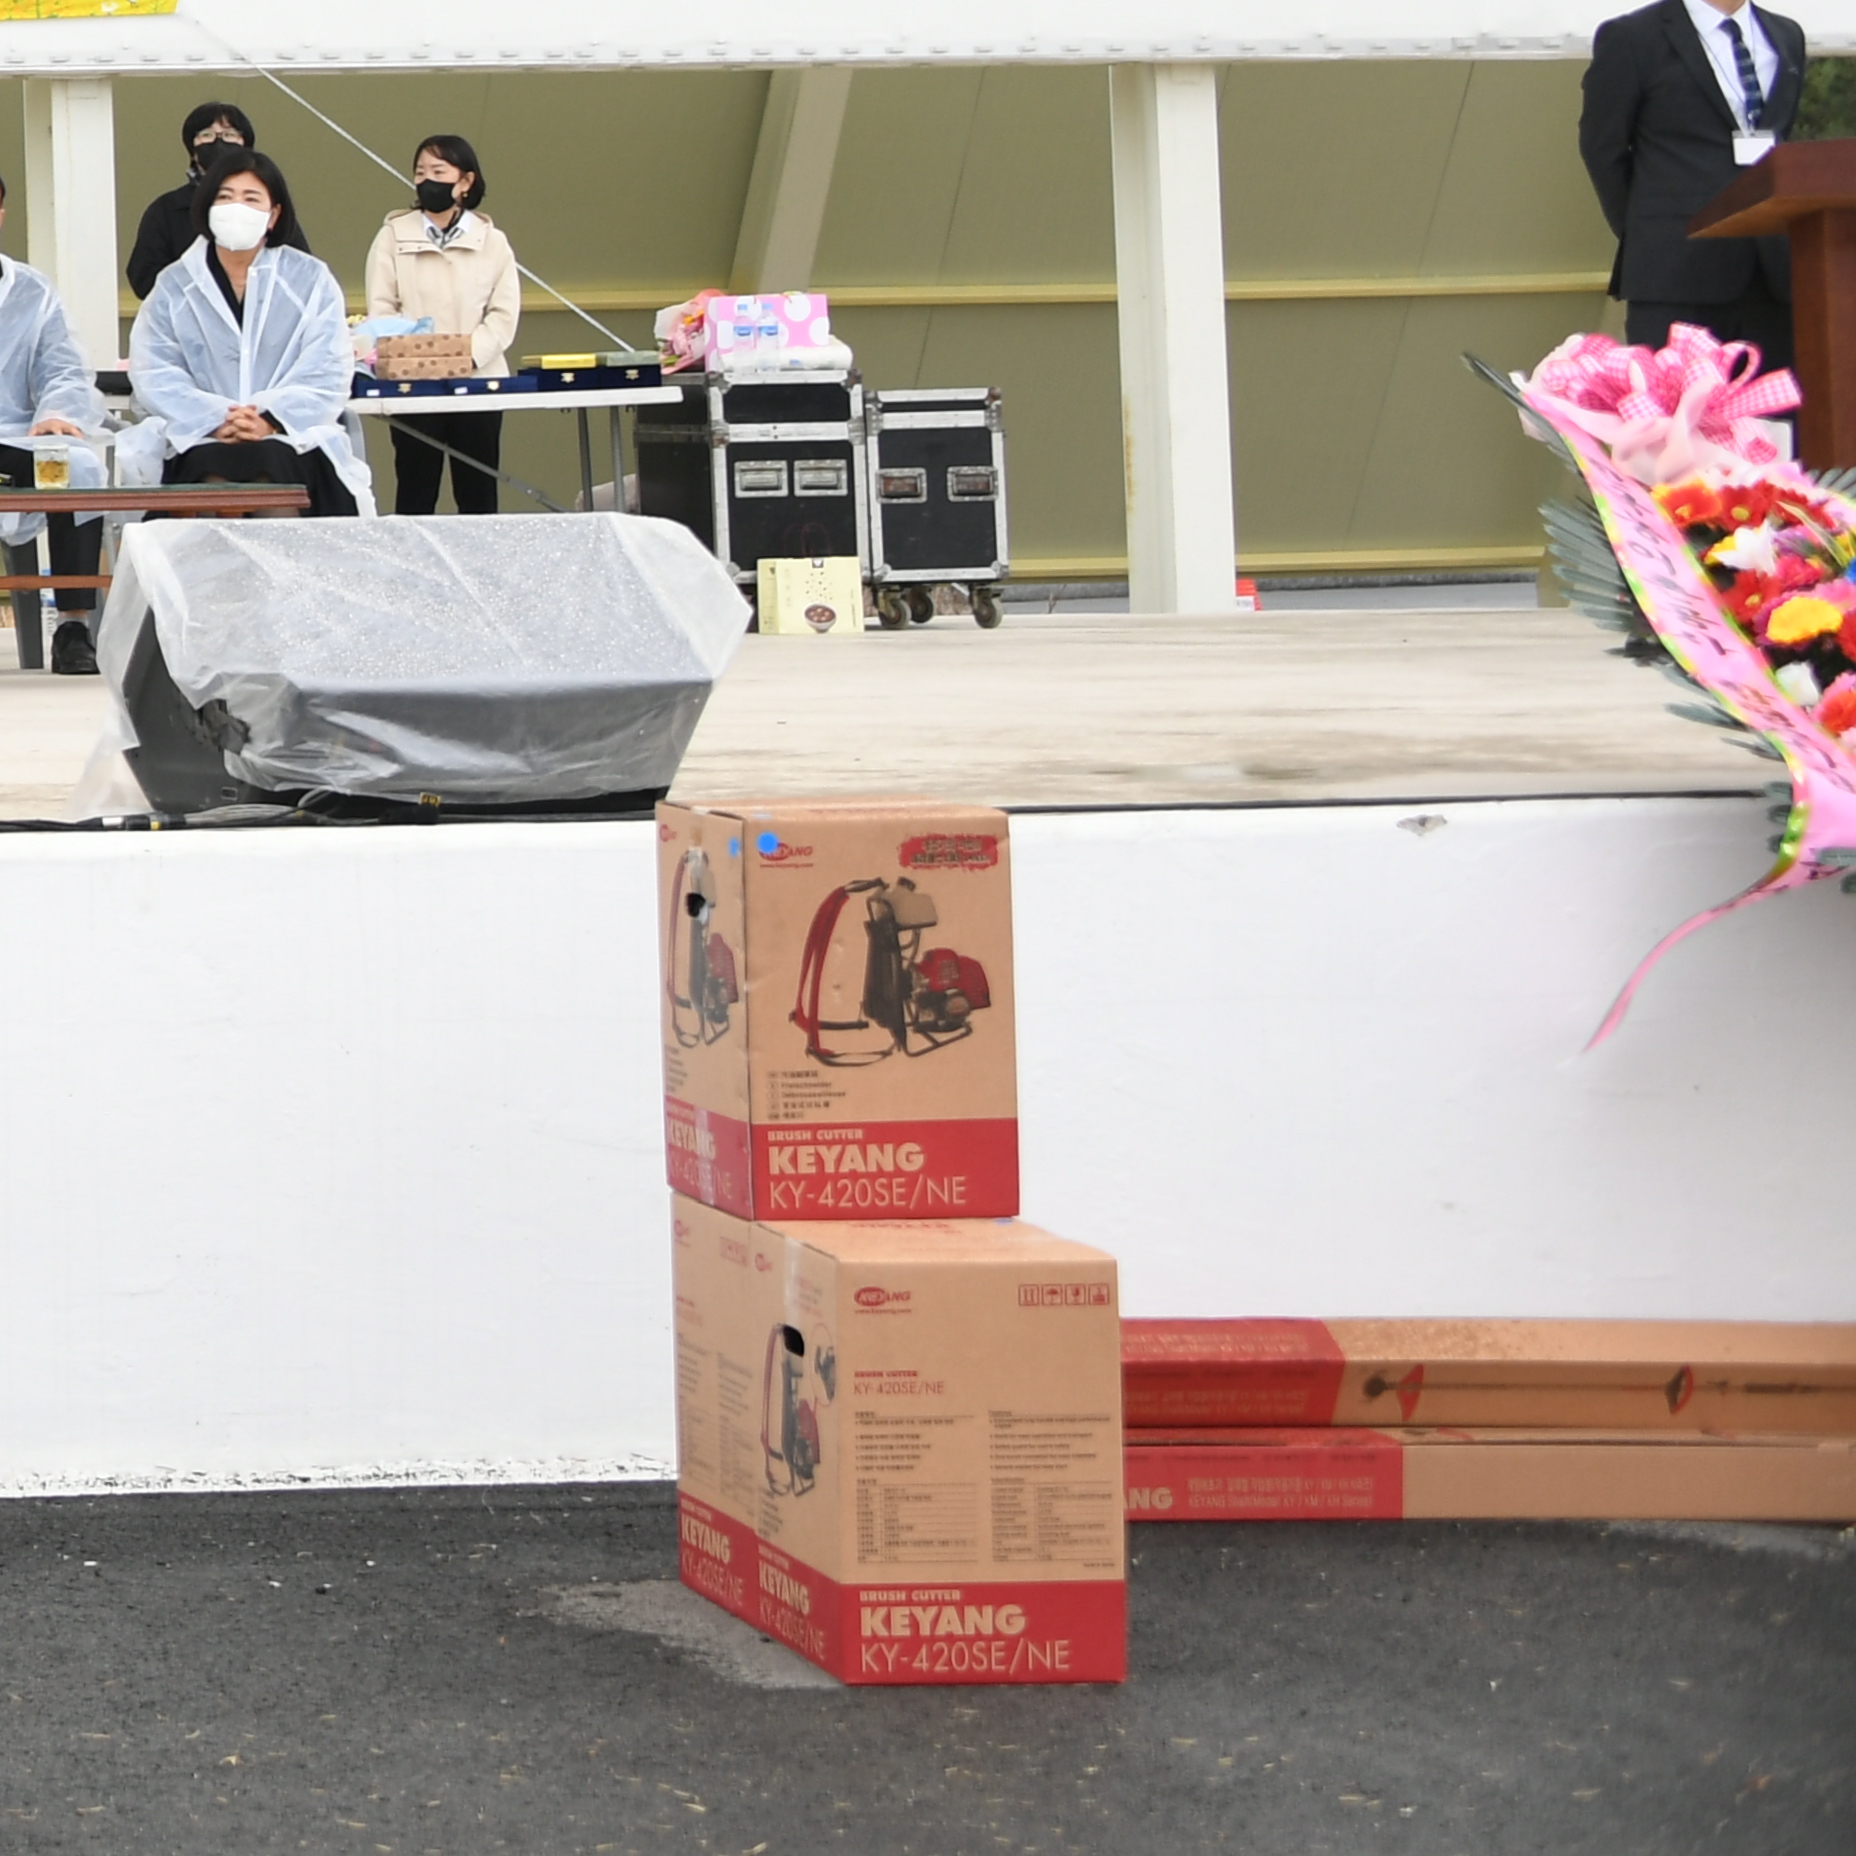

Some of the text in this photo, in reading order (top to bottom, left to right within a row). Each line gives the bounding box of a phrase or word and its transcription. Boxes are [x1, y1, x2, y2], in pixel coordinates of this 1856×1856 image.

[767, 1128, 864, 1141] BRUSH CUTTER
[767, 1141, 925, 1175] KEYANG
[770, 1174, 967, 1211] KY-420SE/NE
[853, 1380, 945, 1396] KY-420SE/NE
[680, 1512, 731, 1565] KEYANG
[758, 1558, 810, 1616] KEYANG
[860, 1589, 962, 1602] BRUSH CUTTER
[860, 1604, 1027, 1639] KEYANG
[860, 1640, 1072, 1676] KY-420SE/NE
